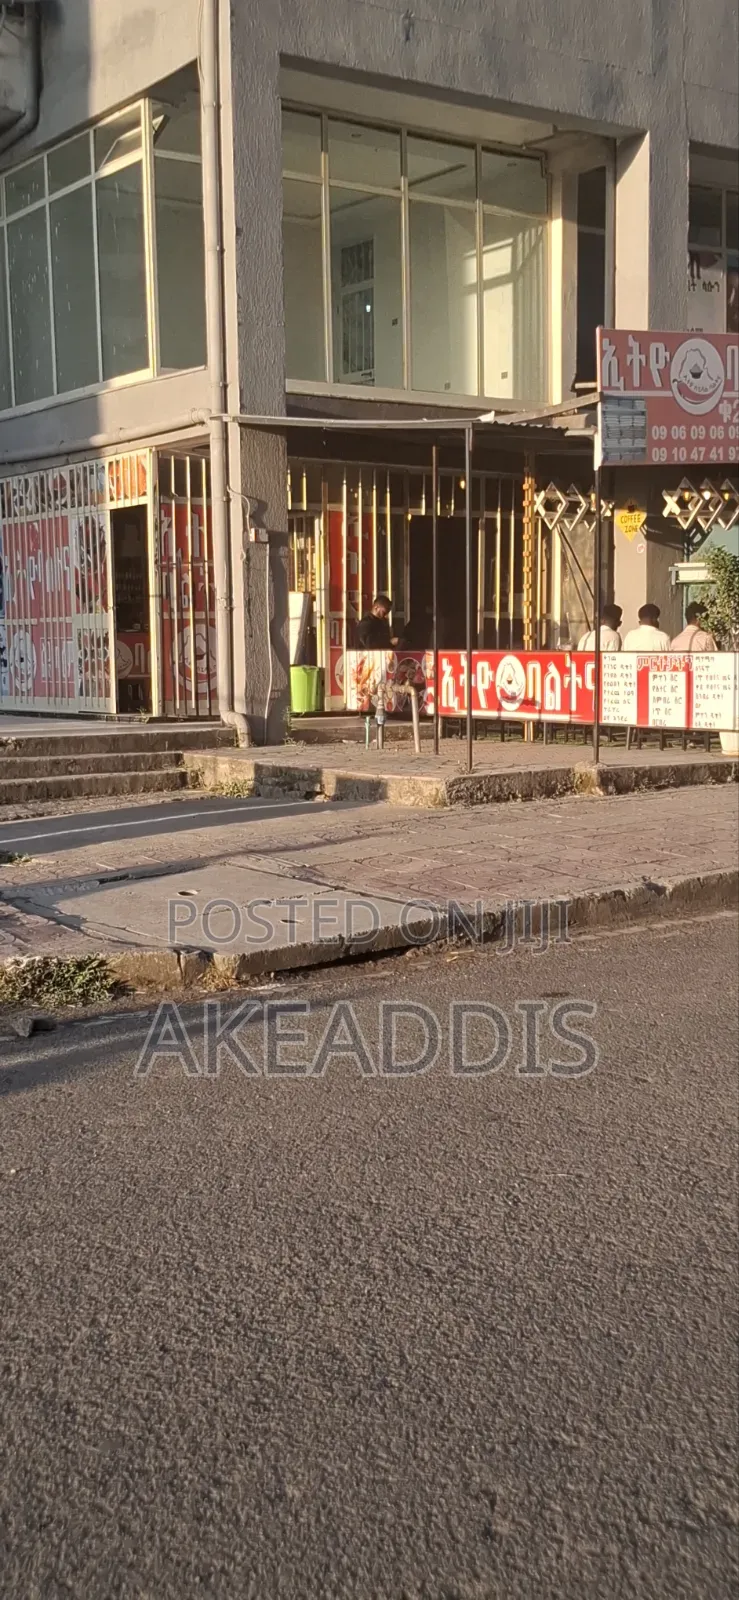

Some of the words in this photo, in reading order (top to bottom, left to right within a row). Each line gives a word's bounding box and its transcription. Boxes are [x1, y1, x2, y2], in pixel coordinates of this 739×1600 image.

[602, 334, 670, 391] ኢትዮ
[652, 425, 667, 440] 09
[671, 425, 686, 440] 06
[690, 425, 706, 440] 09
[709, 425, 725, 440] 06
[652, 447, 667, 462] 09
[671, 447, 687, 462] 10
[690, 447, 706, 462] 47
[709, 446, 724, 462] 41
[620, 514, 641, 524] COFFEE
[625, 525, 638, 533] ZONE
[441, 653, 494, 711] ኢትዮ
